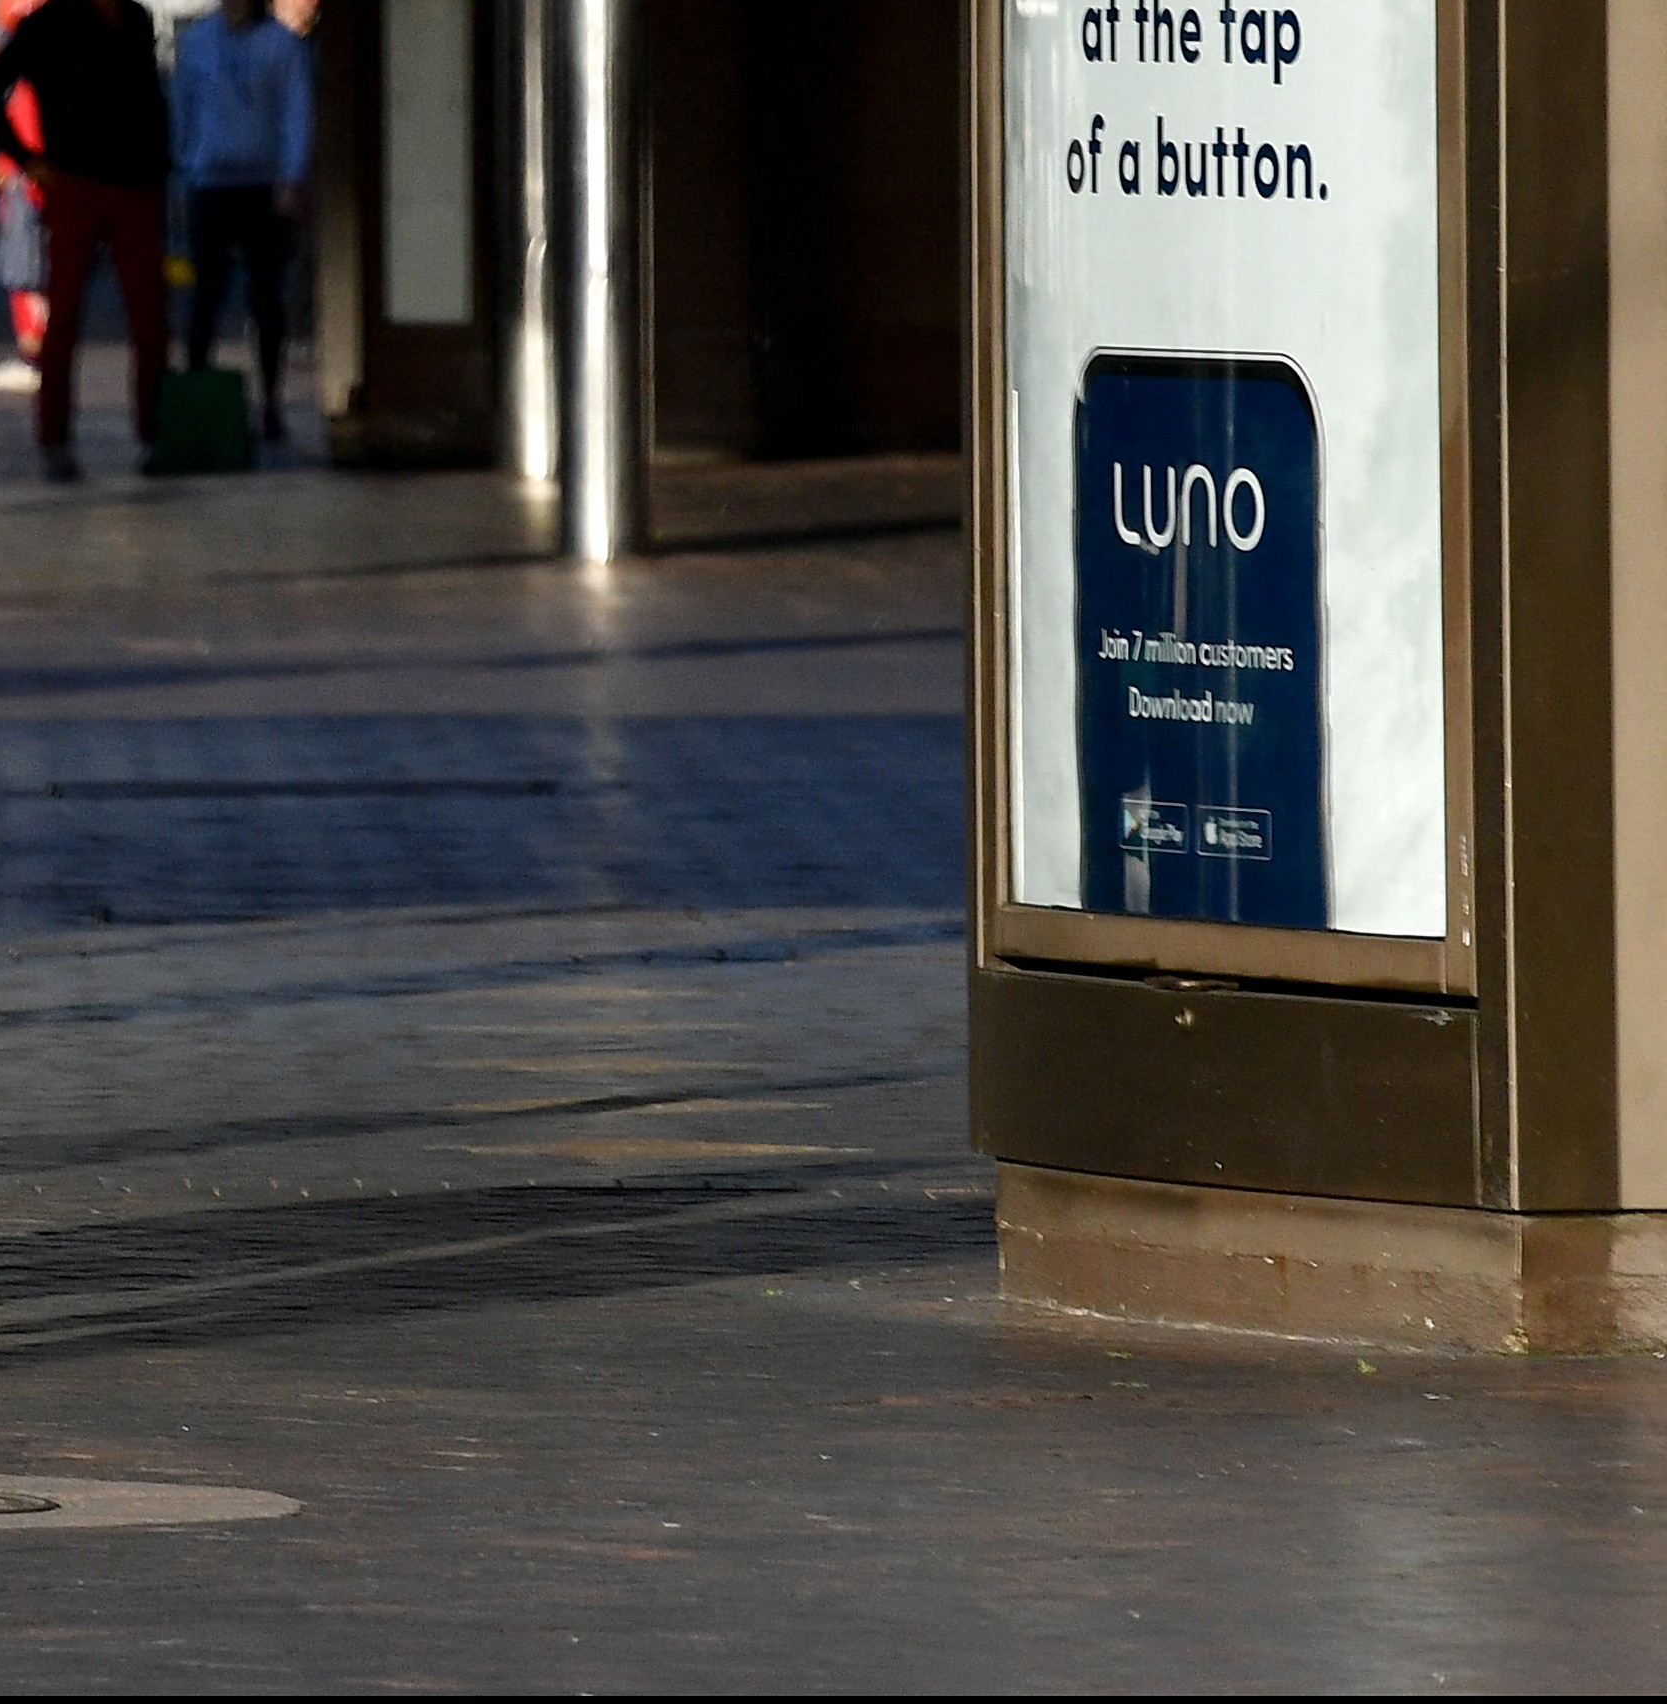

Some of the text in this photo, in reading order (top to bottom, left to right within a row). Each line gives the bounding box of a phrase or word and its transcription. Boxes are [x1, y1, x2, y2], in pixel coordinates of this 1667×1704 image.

[1066, 113, 1329, 201] of a button.
[1098, 628, 1295, 671] Join 7 million customers
[1128, 686, 1255, 725] Download now
